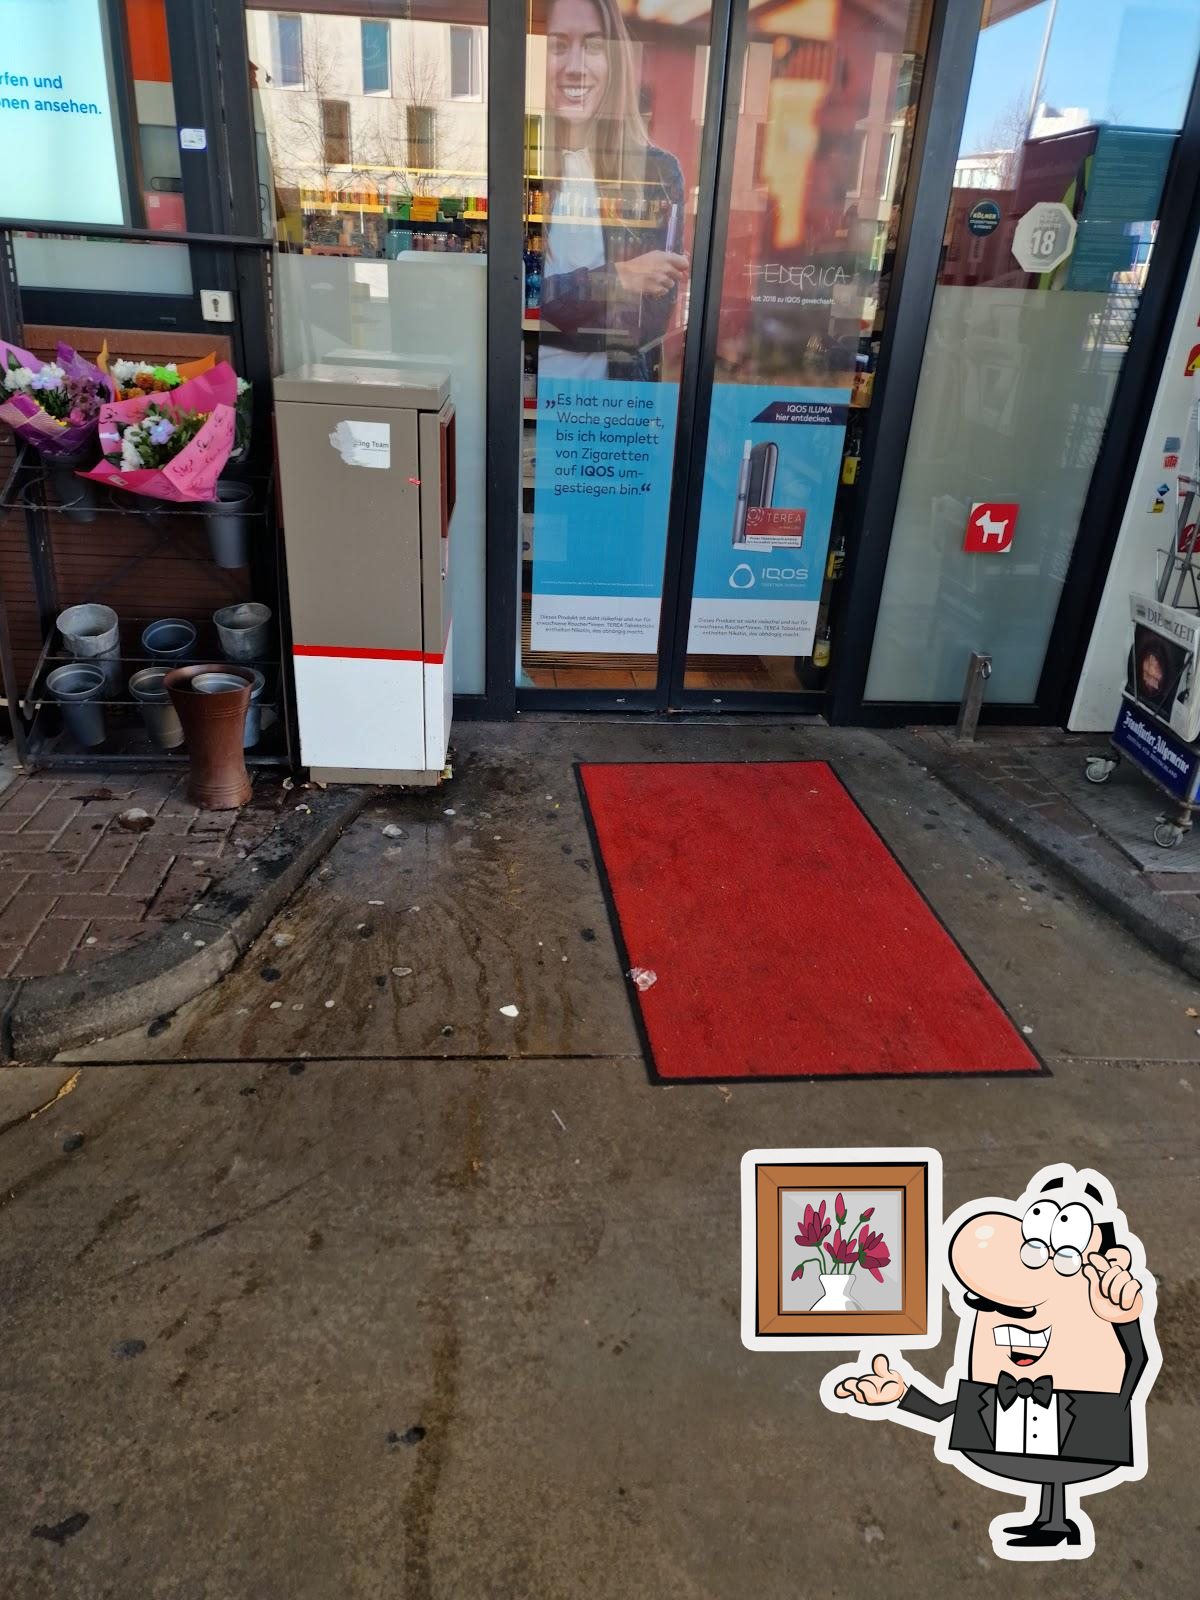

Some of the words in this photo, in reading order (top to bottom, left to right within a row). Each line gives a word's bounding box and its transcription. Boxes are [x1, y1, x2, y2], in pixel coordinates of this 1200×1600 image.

[33, 74, 63, 89] und
[0, 97, 30, 110] nen
[34, 99, 102, 115] ansehen.
[1031, 230, 1056, 255] 18
[742, 260, 850, 291] FEDERICA
[575, 394, 599, 408] hat
[602, 398, 624, 408] nur
[626, 396, 654, 409] eine
[786, 404, 808, 413] IQOS
[808, 405, 832, 414] ILUMA
[557, 411, 601, 425] Woche
[603, 413, 665, 429] gedauert,
[775, 413, 790, 421] hier
[790, 414, 831, 423] entdecken.
[556, 429, 574, 441] bis
[578, 430, 596, 442] ich
[599, 431, 660, 446] komplett
[555, 449, 578, 459] von
[581, 448, 649, 463] Zigaretten
[555, 464, 577, 476] auf
[580, 465, 615, 477] IQOS
[618, 469, 644, 478] um-
[554, 482, 616, 498] gestiegen
[767, 513, 802, 523] TEREA
[762, 567, 809, 581] IQOS
[1147, 607, 1163, 628] DIE
[1173, 621, 1196, 644] ZEIT
[1123, 710, 1156, 747] Frankfurter
[1152, 735, 1190, 775] Allgemeine
